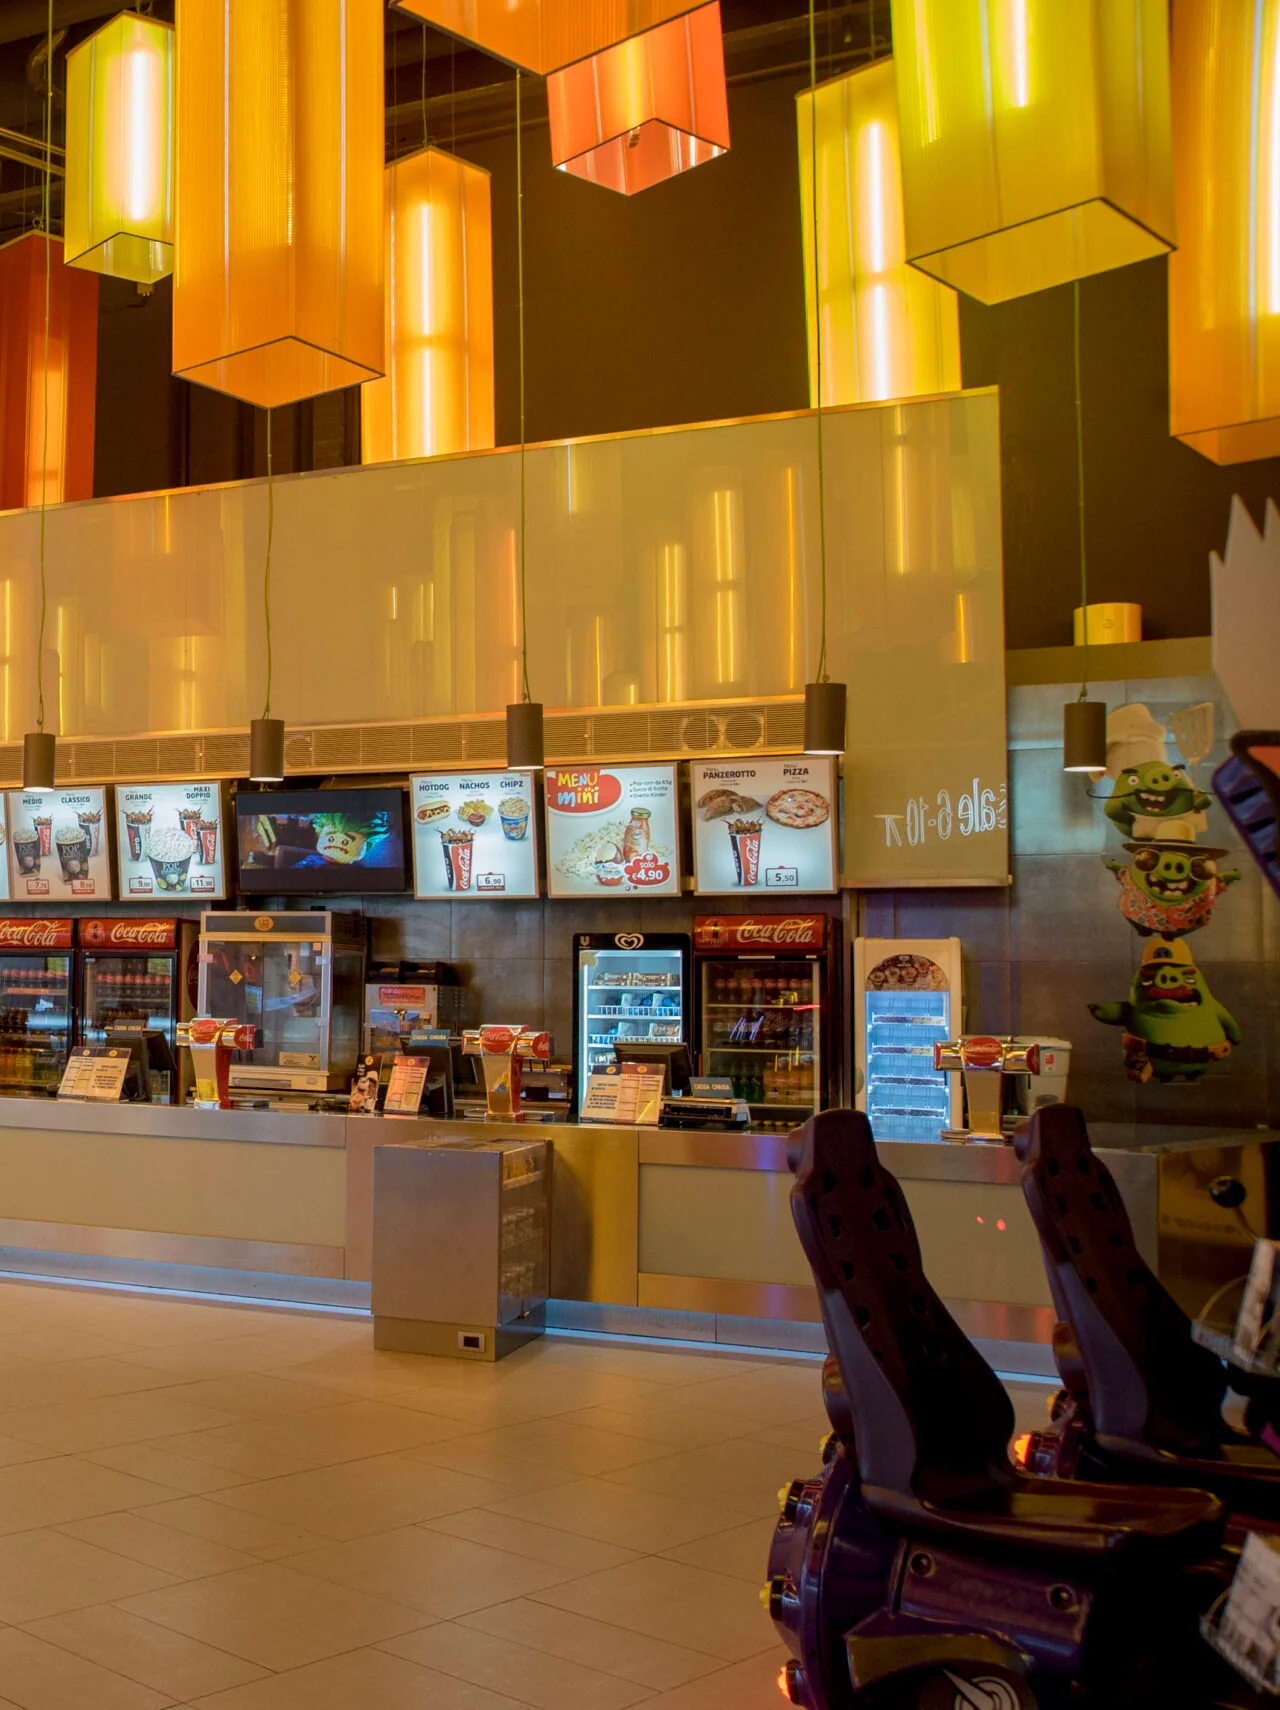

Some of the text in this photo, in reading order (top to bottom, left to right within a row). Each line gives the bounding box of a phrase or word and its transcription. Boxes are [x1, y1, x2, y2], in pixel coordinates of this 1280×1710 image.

[704, 770, 756, 780] PANZEROTTO
[784, 768, 809, 776] PIZZA
[500, 780, 524, 788] CHIPZ
[558, 772, 599, 788] MENU
[419, 784, 450, 792] HOTDOG
[460, 782, 490, 790] NACHOS
[61, 796, 90, 804] CLASSICO
[186, 792, 210, 800] DOPPIO
[558, 786, 600, 807] mini
[632, 870, 663, 881] €4,90
[110, 922, 170, 944] Coca-Cola
[736, 919, 815, 944] Coca-Cola
